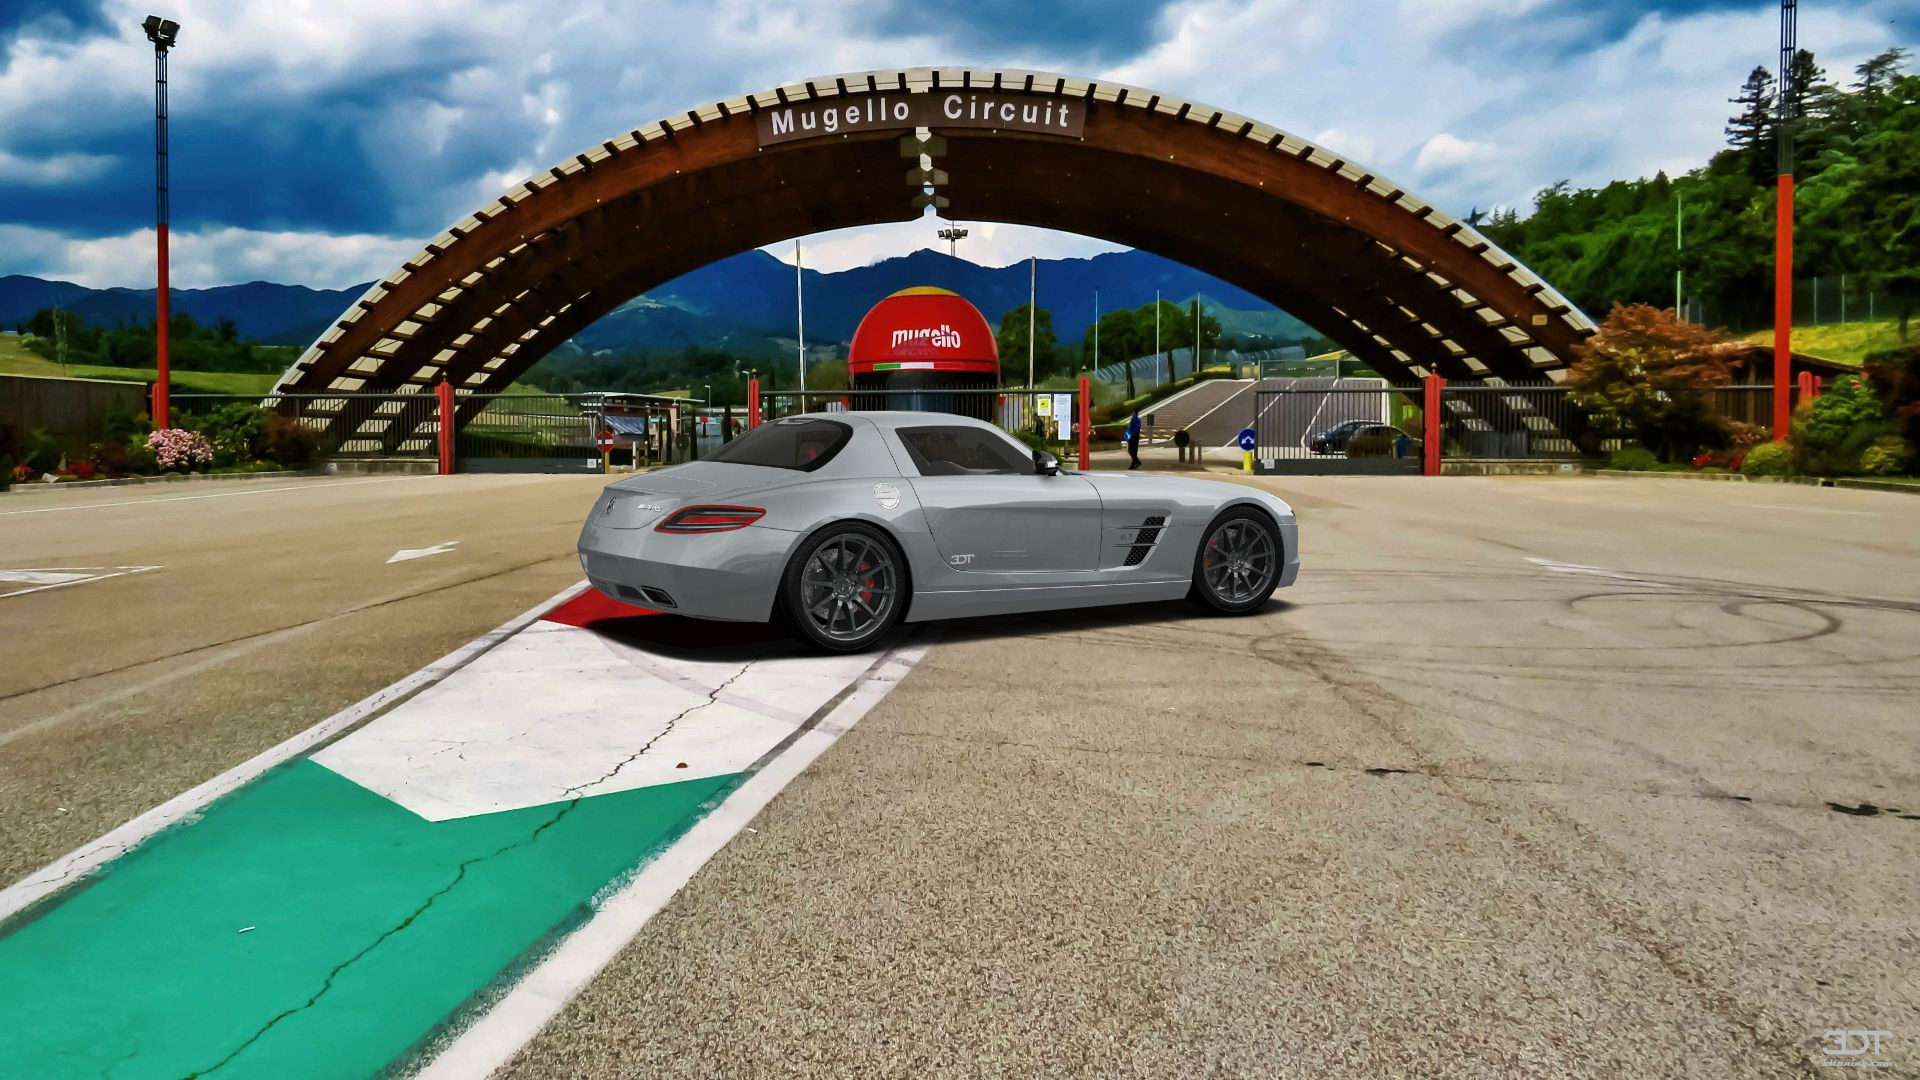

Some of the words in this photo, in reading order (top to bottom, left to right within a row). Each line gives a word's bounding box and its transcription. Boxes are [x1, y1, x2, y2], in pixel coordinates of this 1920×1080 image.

[771, 97, 909, 135] Mugello
[943, 94, 1069, 128] Circuit
[892, 324, 961, 349] mugello
